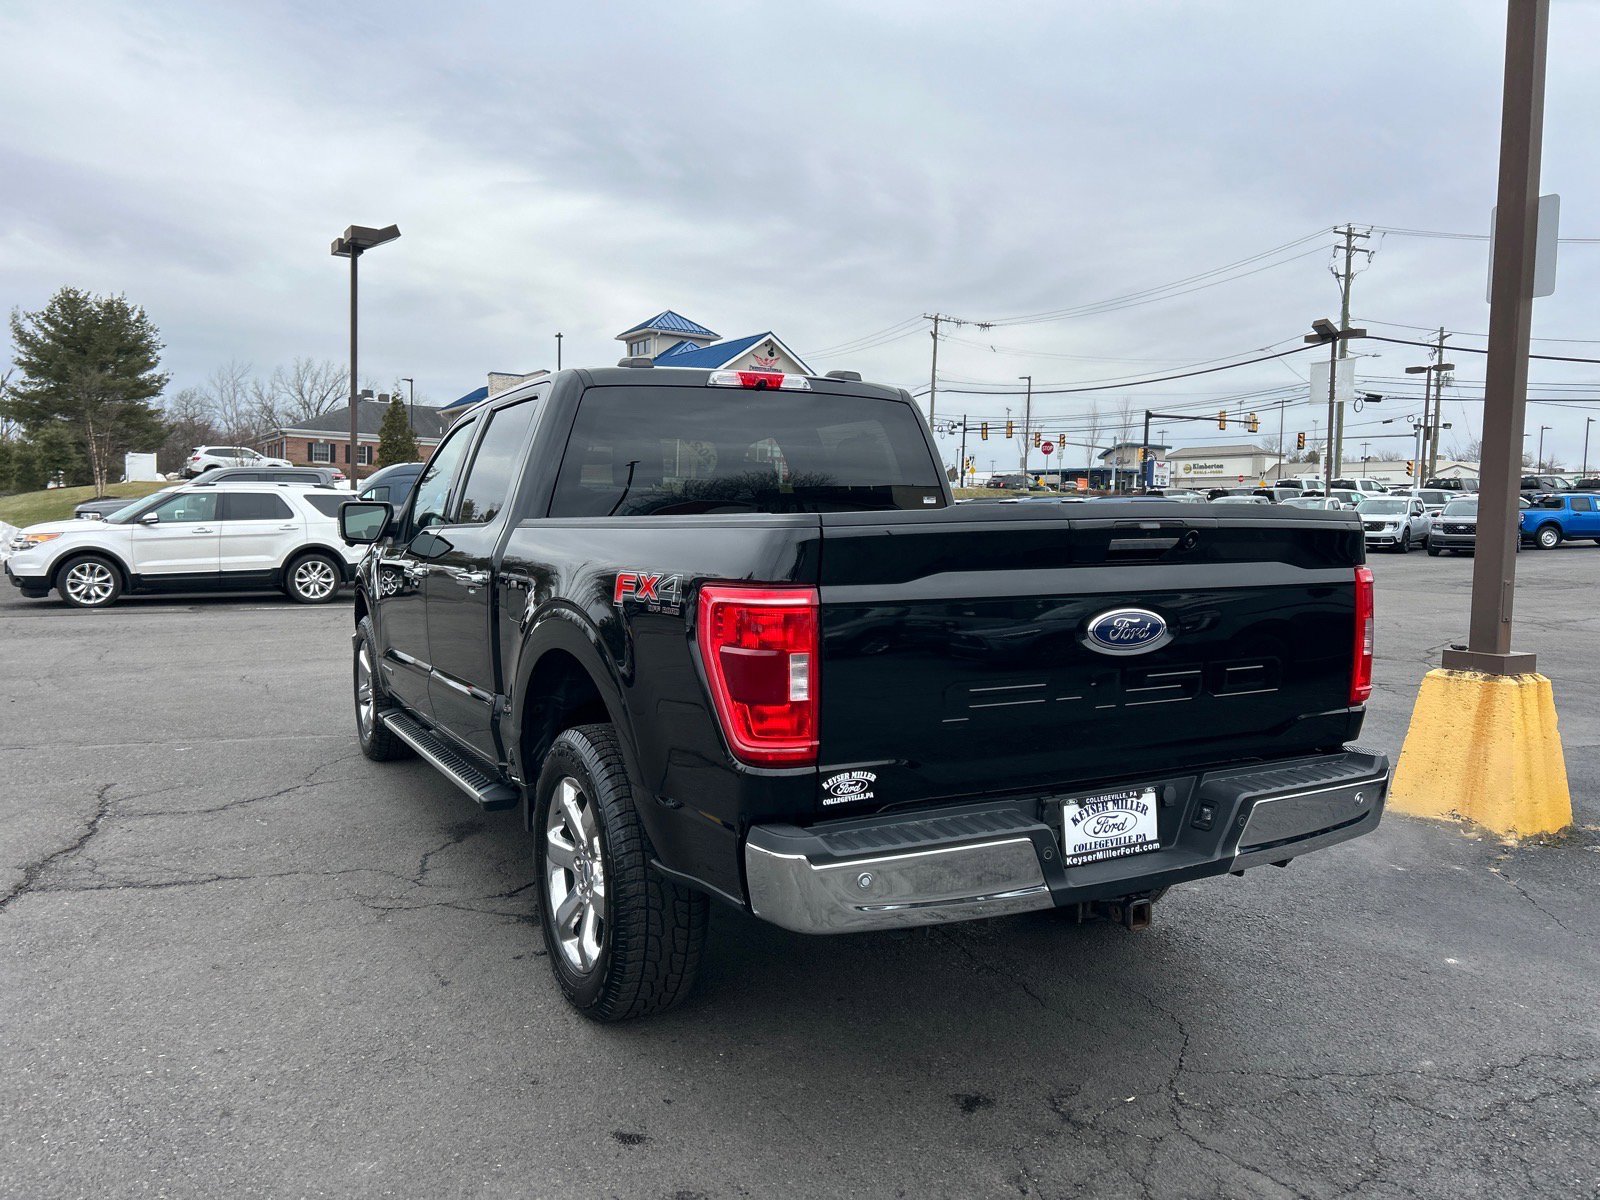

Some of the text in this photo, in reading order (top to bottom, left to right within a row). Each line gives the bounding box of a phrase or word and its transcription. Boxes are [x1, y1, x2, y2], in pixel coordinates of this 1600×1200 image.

[613, 570, 683, 607] FX4
[1109, 618, 1151, 640] Ford
[822, 771, 877, 790] KEYSER MILLER
[836, 781, 862, 794] Ford
[1070, 799, 1149, 827] KEYSER MILLER
[1093, 814, 1128, 835] Ford
[1066, 842, 1160, 865] KeyserMillerFord.com
